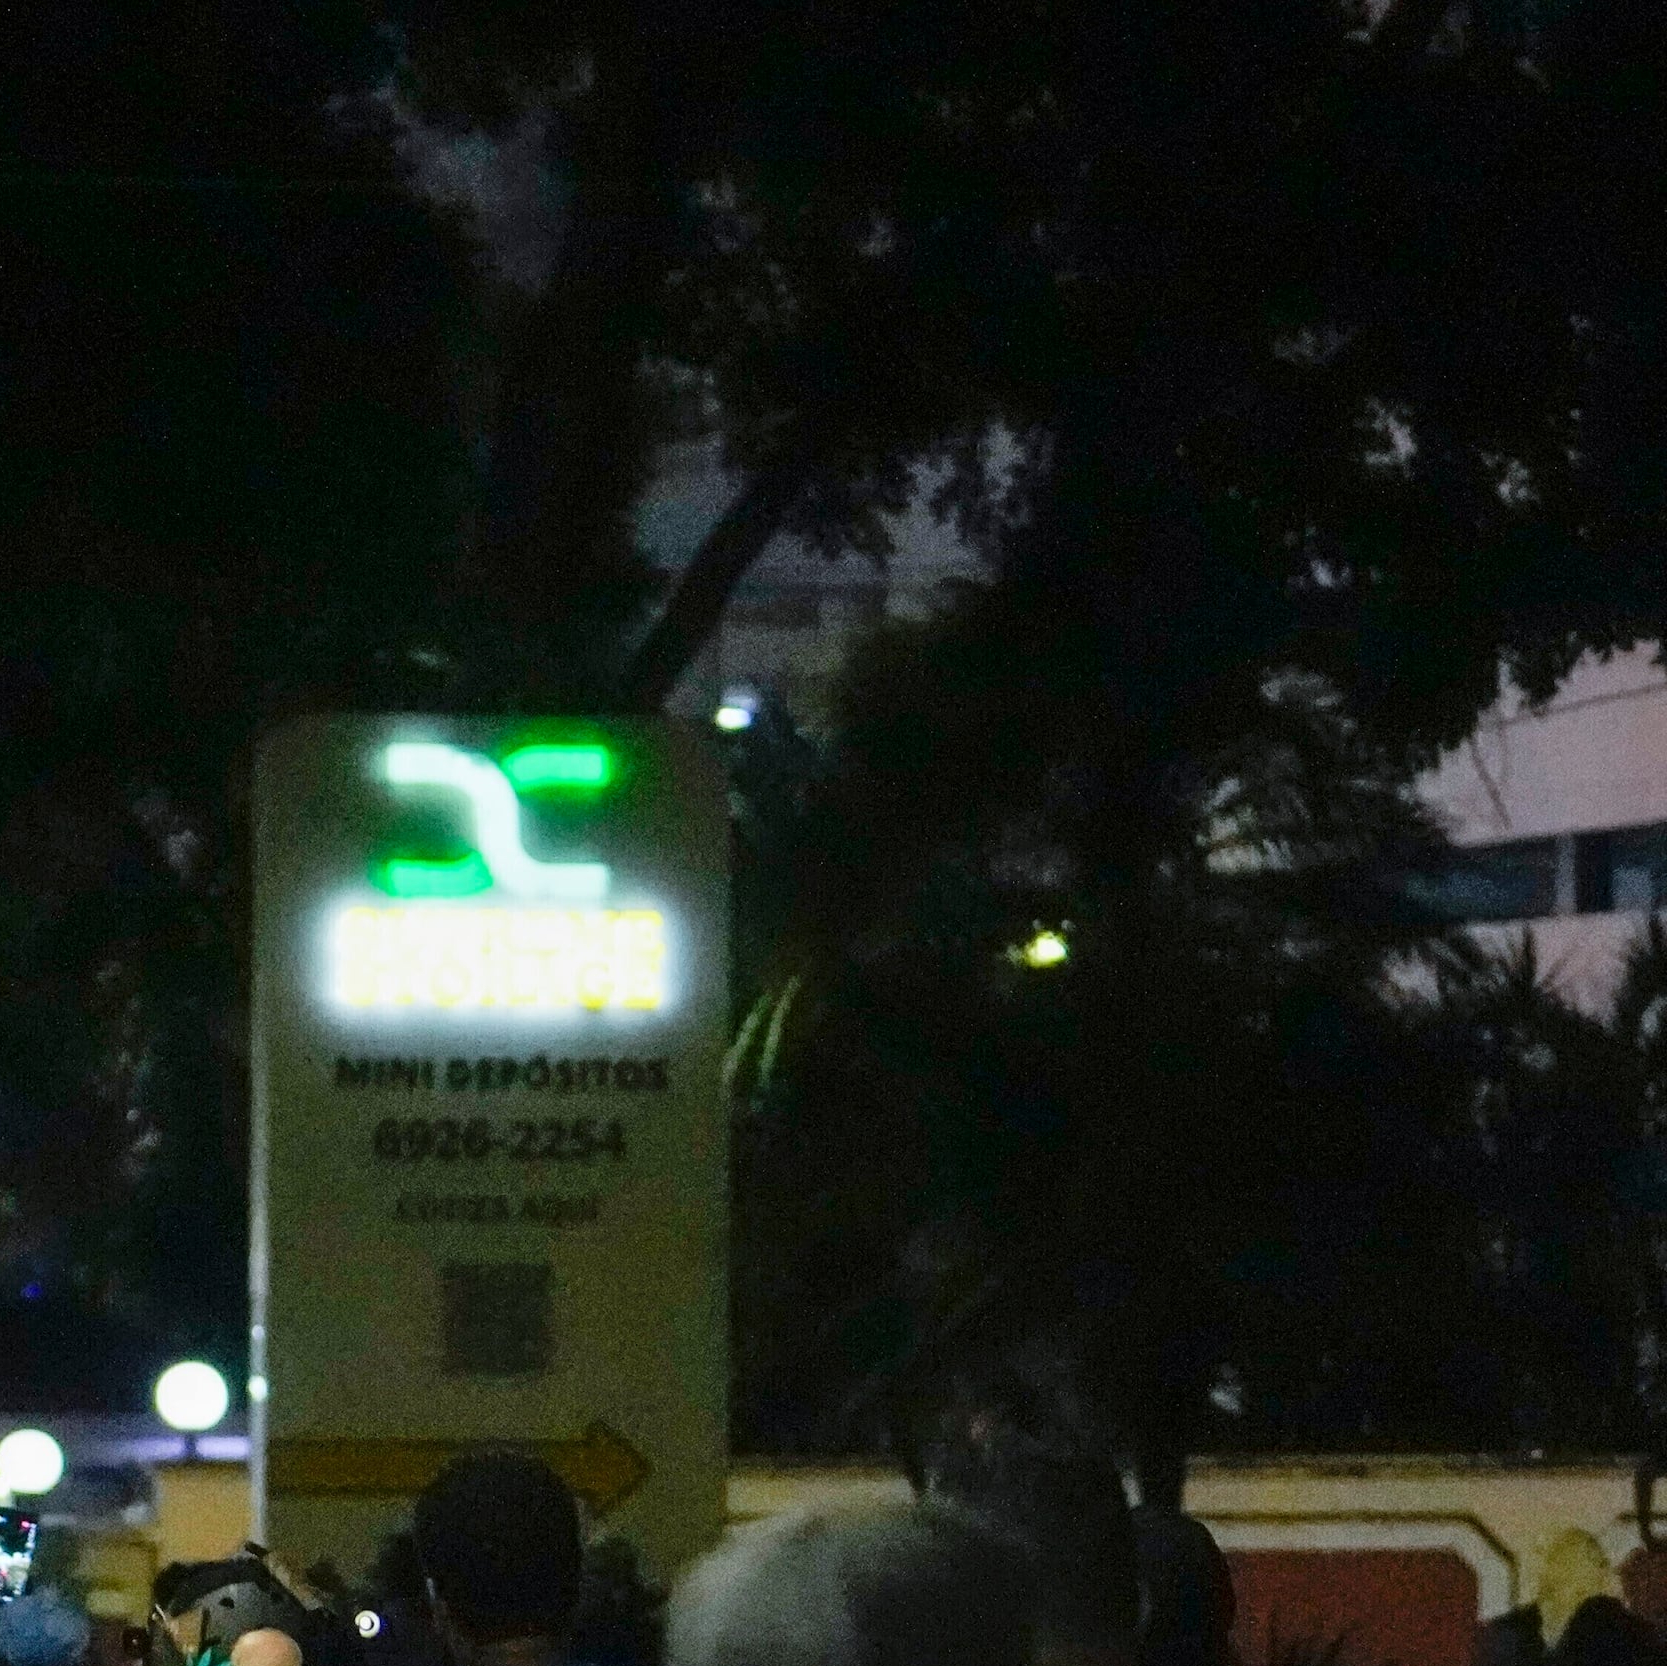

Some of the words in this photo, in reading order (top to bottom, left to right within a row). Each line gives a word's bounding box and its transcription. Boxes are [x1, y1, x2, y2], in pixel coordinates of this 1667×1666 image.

[334, 1057, 434, 1090] MINI
[447, 1054, 669, 1091] DEPÓSITOS
[373, 1117, 627, 1161] 6926-2254
